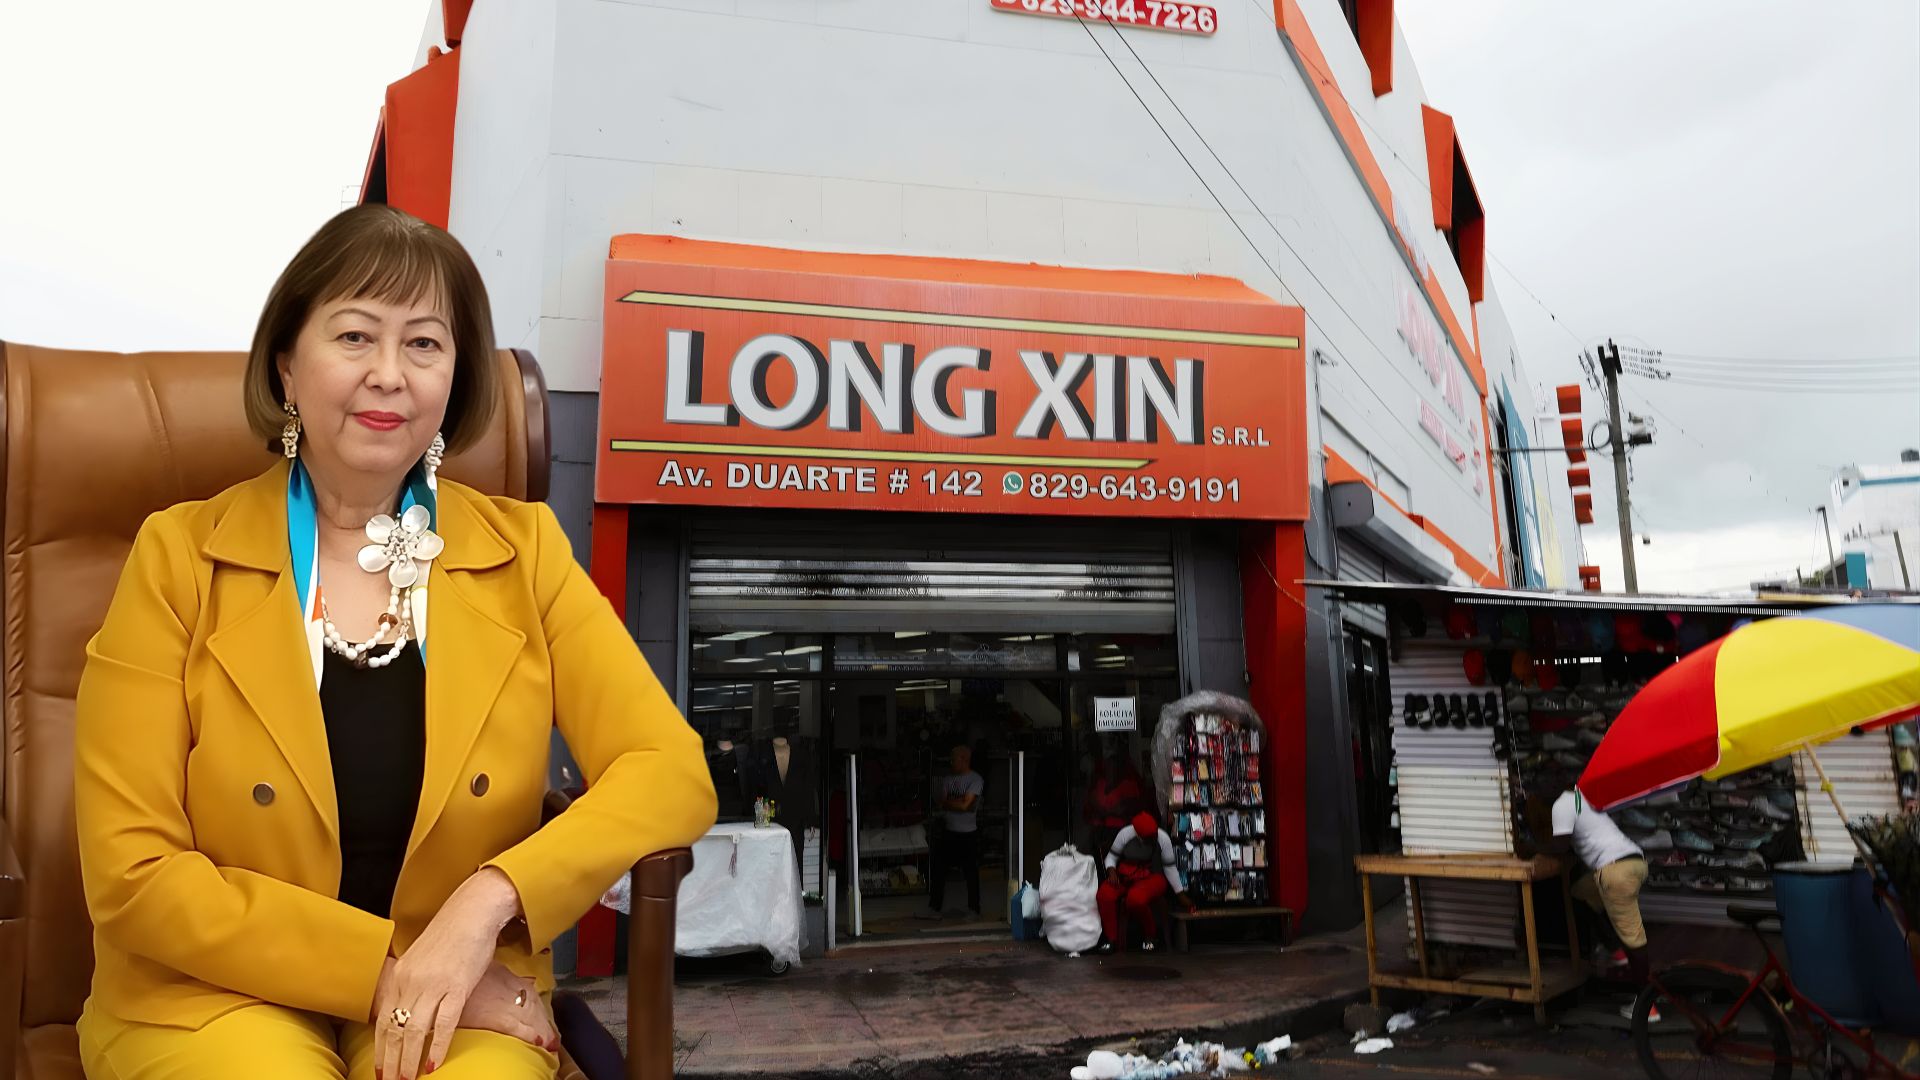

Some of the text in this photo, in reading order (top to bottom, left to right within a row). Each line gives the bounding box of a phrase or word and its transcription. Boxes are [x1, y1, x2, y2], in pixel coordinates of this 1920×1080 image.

[664, 328, 1270, 446] LONG XIN S.R.L
[657, 460, 1240, 502] Av. DUARTE # 142 829-643-9191
